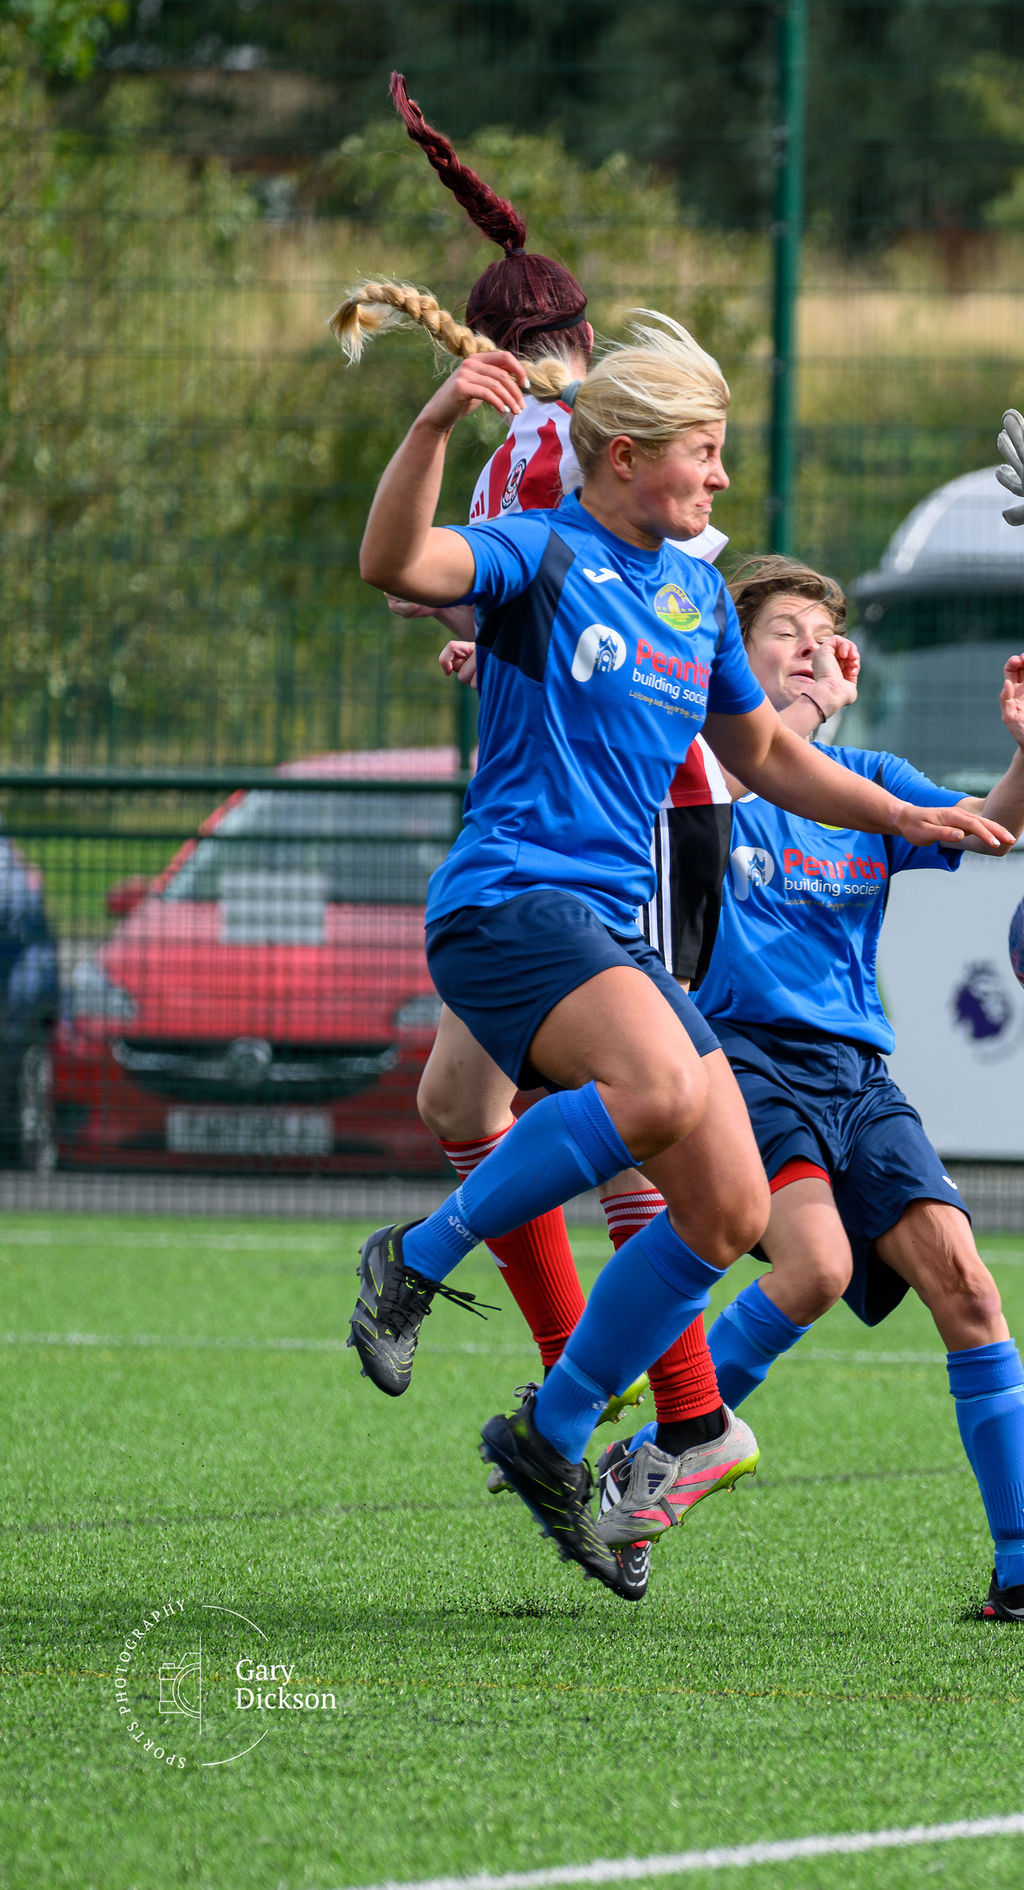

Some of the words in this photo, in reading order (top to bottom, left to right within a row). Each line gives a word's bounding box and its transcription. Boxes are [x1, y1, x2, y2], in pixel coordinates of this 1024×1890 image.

[632, 667, 681, 699] building
[783, 848, 888, 880] Penrith
[784, 877, 841, 897] building
